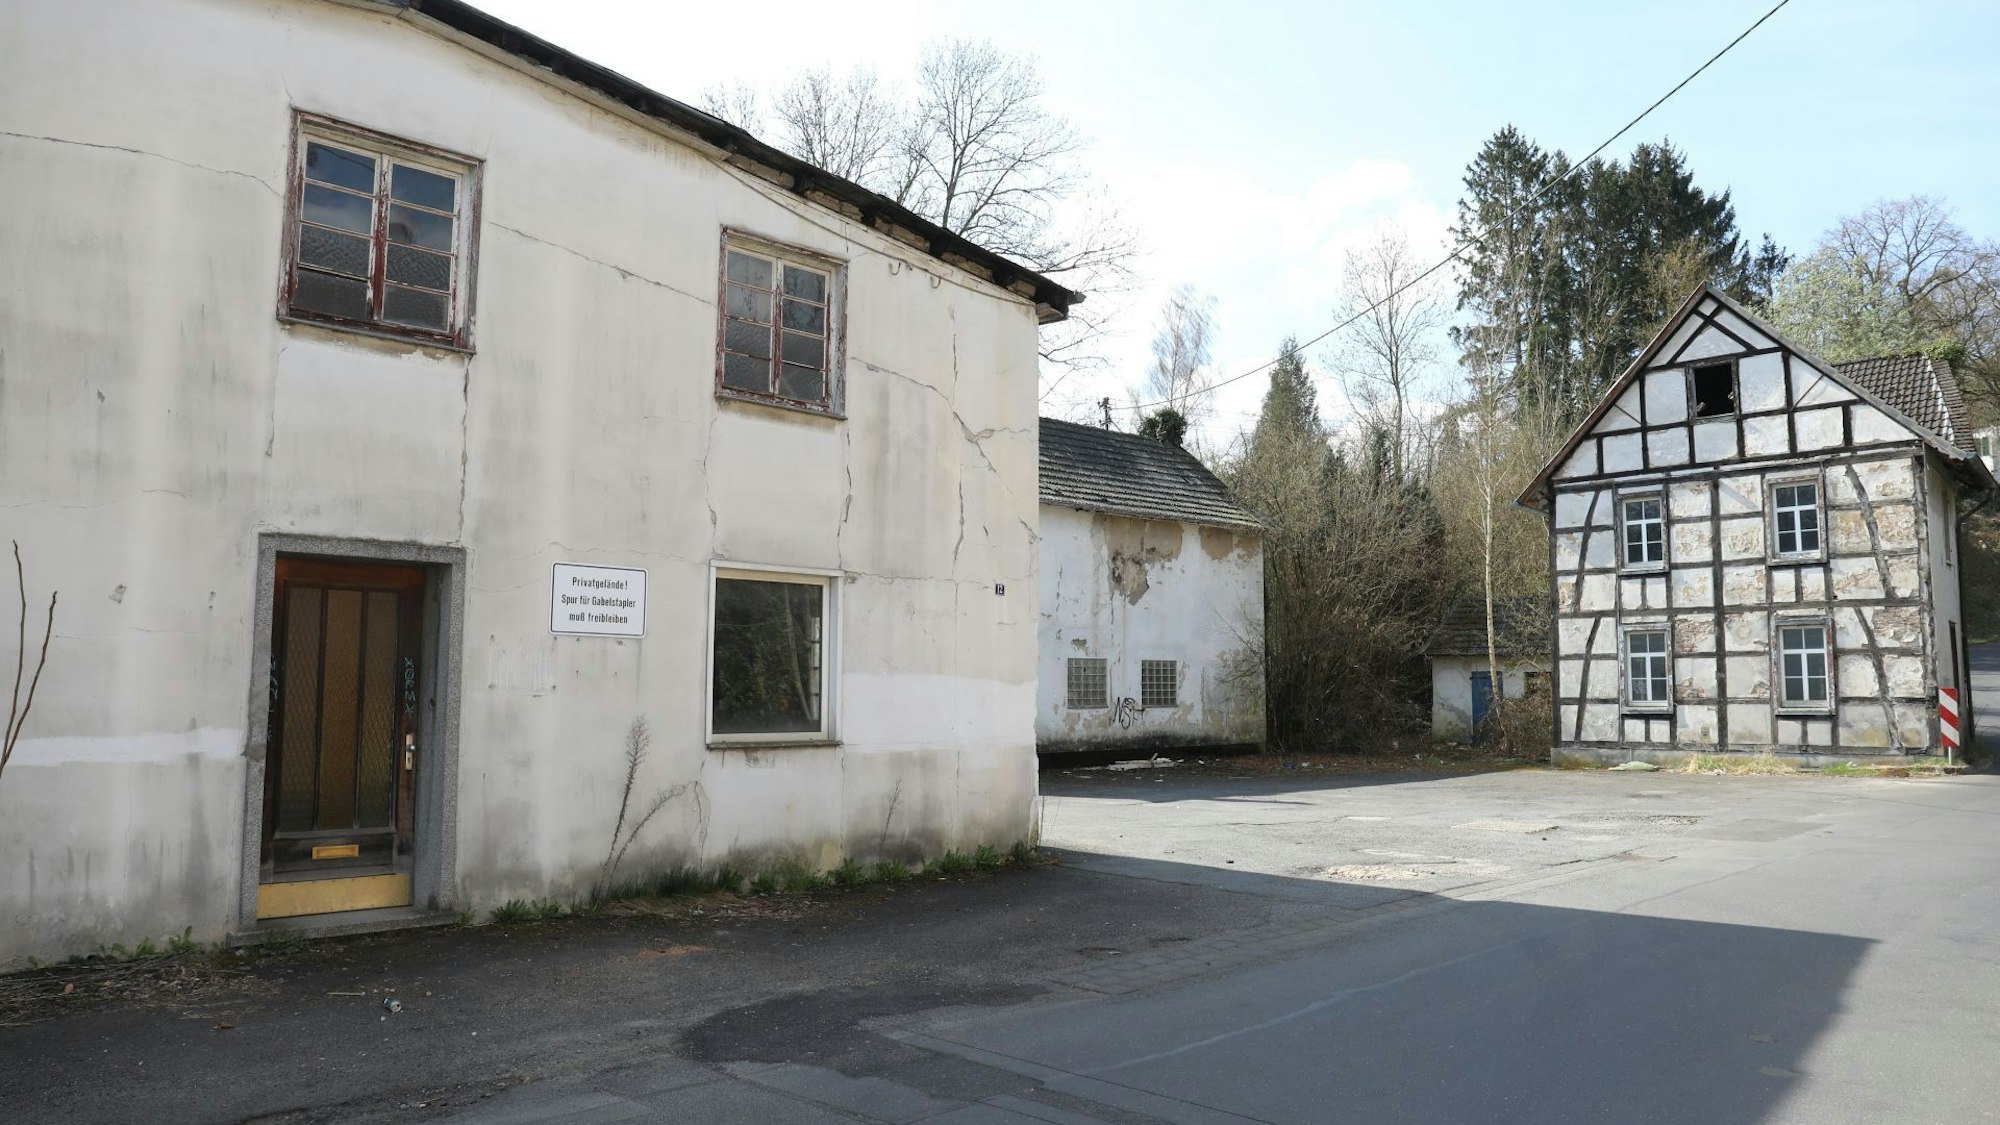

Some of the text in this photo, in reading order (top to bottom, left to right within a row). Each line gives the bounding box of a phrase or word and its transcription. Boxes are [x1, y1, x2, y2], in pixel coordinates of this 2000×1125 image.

[561, 594, 636, 609] Spur für Gabelstapler
[569, 612, 628, 624] muß freibleiben
